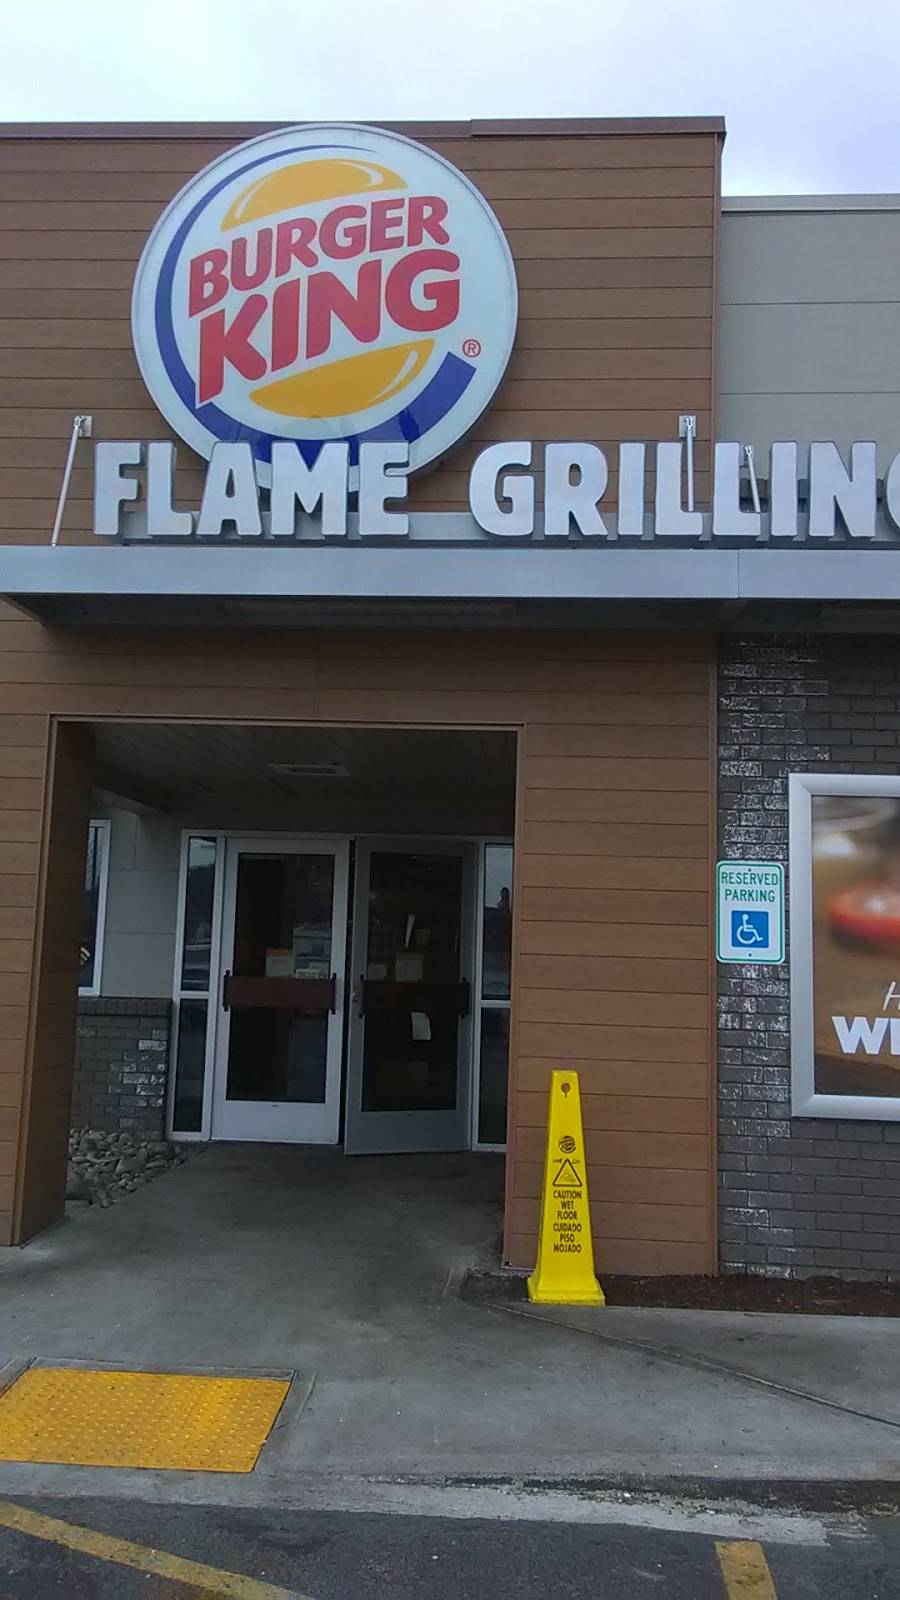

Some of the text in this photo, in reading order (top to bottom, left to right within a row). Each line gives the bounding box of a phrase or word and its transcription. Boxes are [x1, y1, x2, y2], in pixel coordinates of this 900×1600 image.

[188, 196, 450, 318] BURGER
[197, 249, 461, 407] KING
[93, 440, 900, 538] FLAME GRILLIN
[720, 871, 779, 887] RESERVED
[724, 888, 776, 903] PARKING
[553, 1190, 582, 1200] CAUTION
[560, 1200, 574, 1210] WET
[557, 1210, 578, 1220] FLOOR
[553, 1222, 582, 1233] CUIDADO
[560, 1233, 575, 1243] PISO
[553, 1243, 582, 1254] MOJADO
